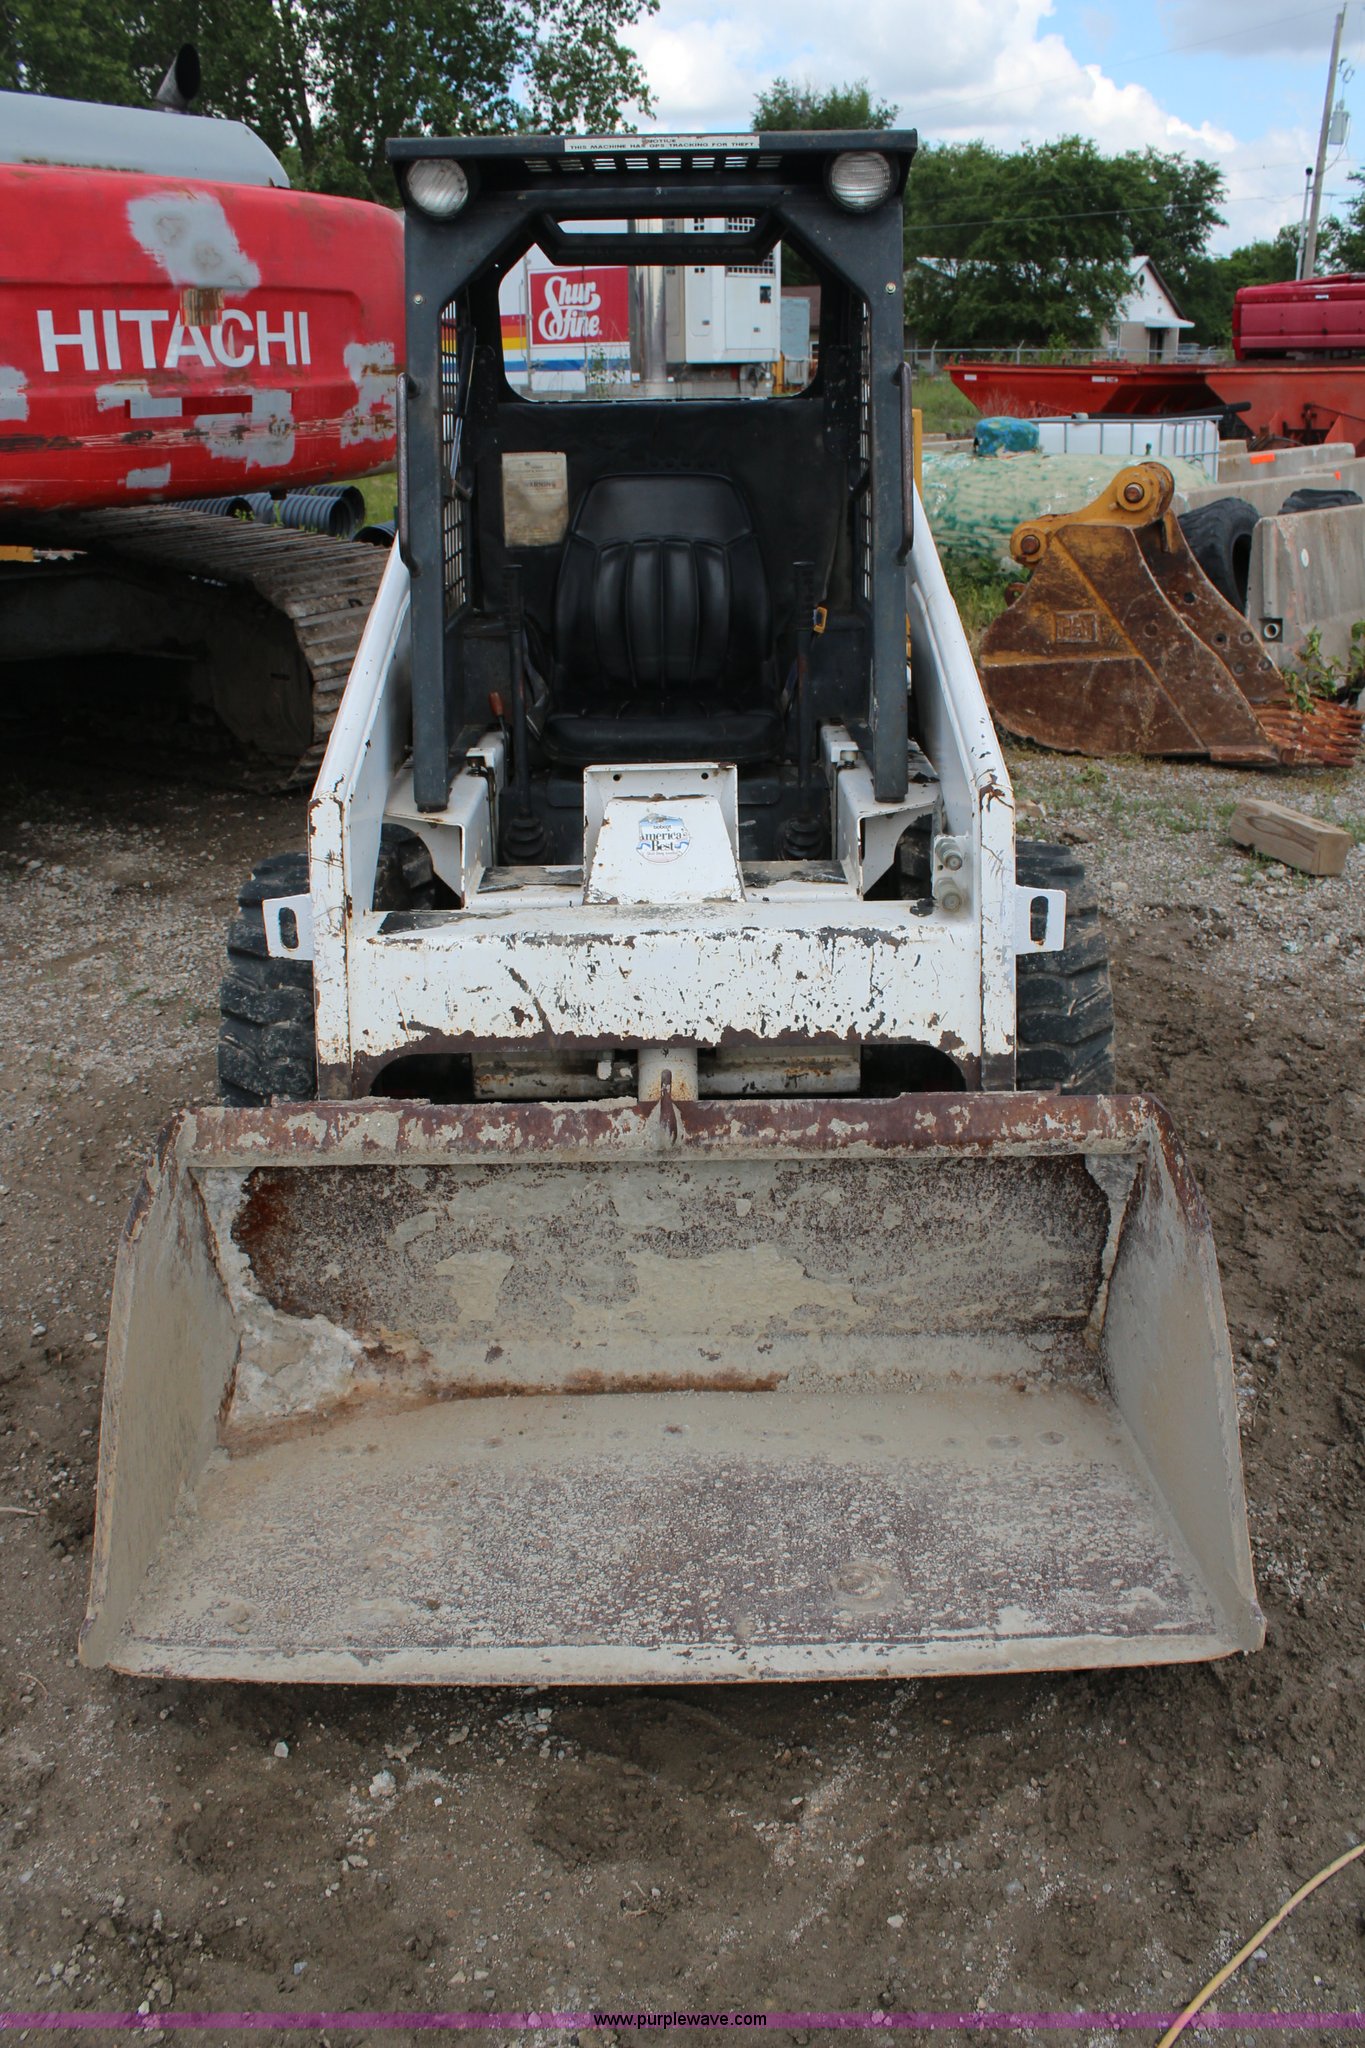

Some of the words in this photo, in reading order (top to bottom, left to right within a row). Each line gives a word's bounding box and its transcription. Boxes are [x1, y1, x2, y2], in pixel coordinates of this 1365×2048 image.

[544, 275, 602, 312] Shur
[36, 308, 311, 372] HITACHI
[651, 840, 674, 851] Best
